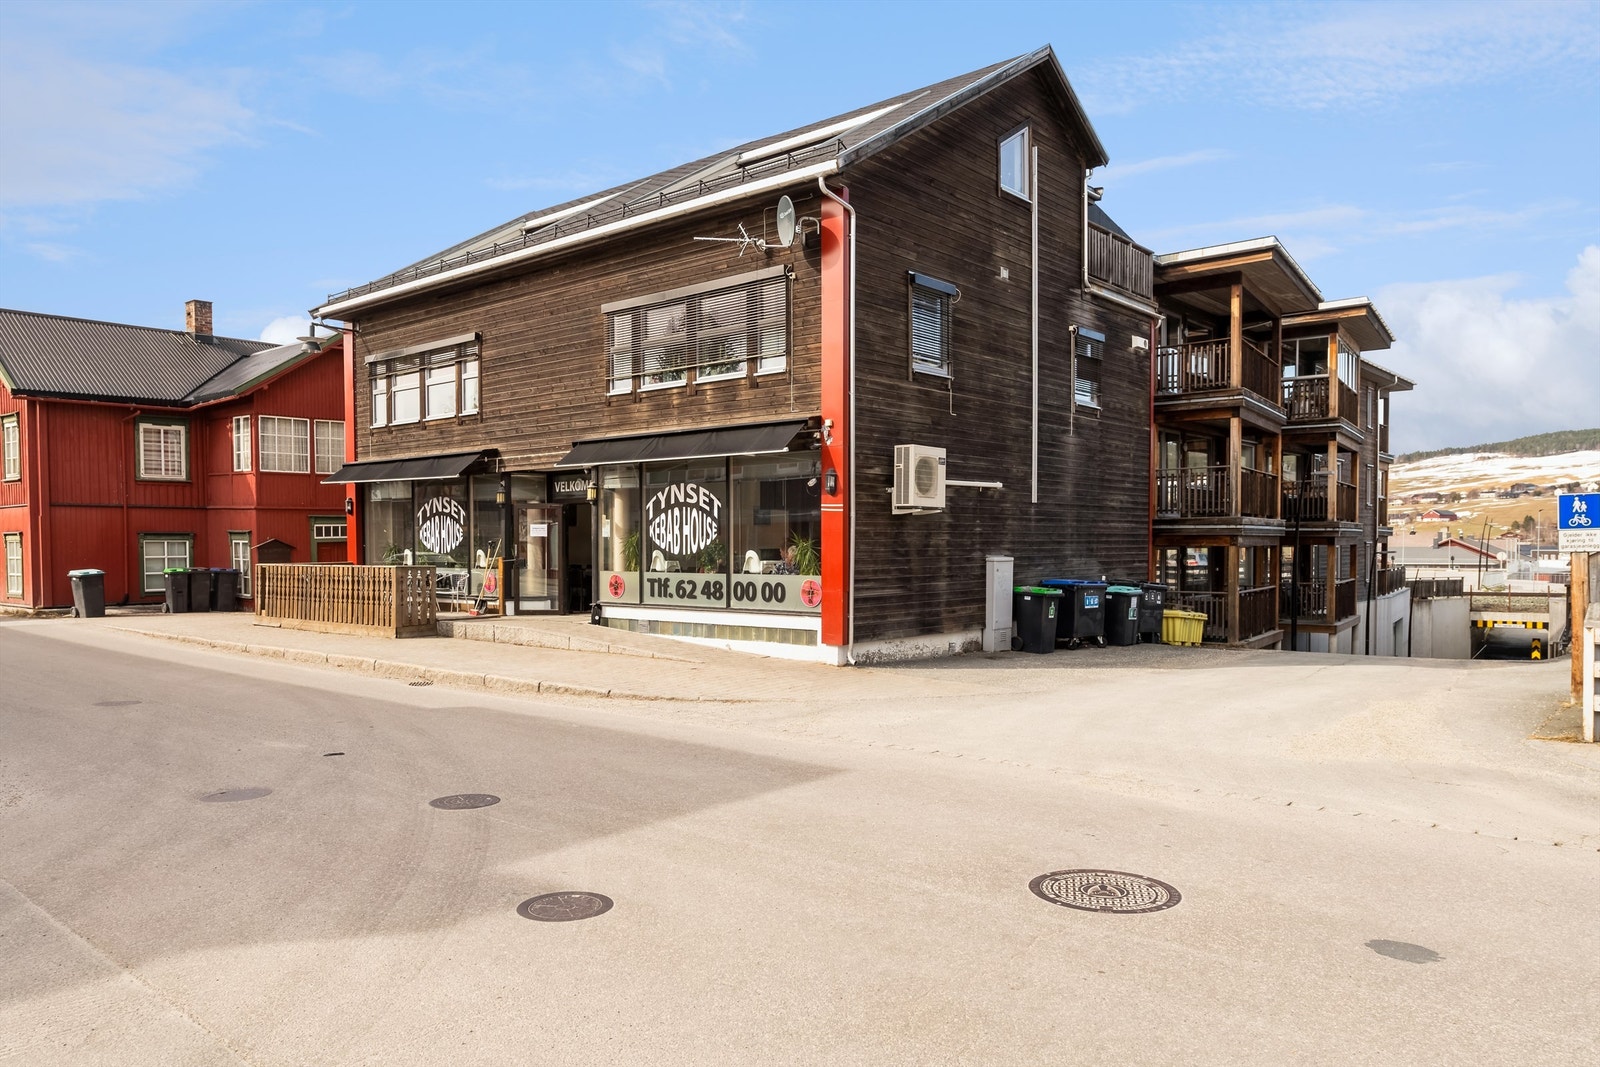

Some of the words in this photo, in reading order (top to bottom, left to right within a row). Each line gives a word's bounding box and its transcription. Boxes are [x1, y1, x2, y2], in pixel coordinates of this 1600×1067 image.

[554, 479, 591, 493] VELKOM
[646, 482, 721, 520] TYNSET
[417, 496, 466, 526] TYNSET
[419, 515, 440, 554] KEBAB
[441, 515, 464, 554] HOUSE
[649, 506, 681, 556] KEBAB
[683, 506, 718, 556] HOUSE
[647, 577, 673, 599] Tlf.
[675, 579, 697, 600] 62
[701, 580, 724, 601] 48
[733, 580, 757, 602] 00
[761, 581, 786, 603] 00
